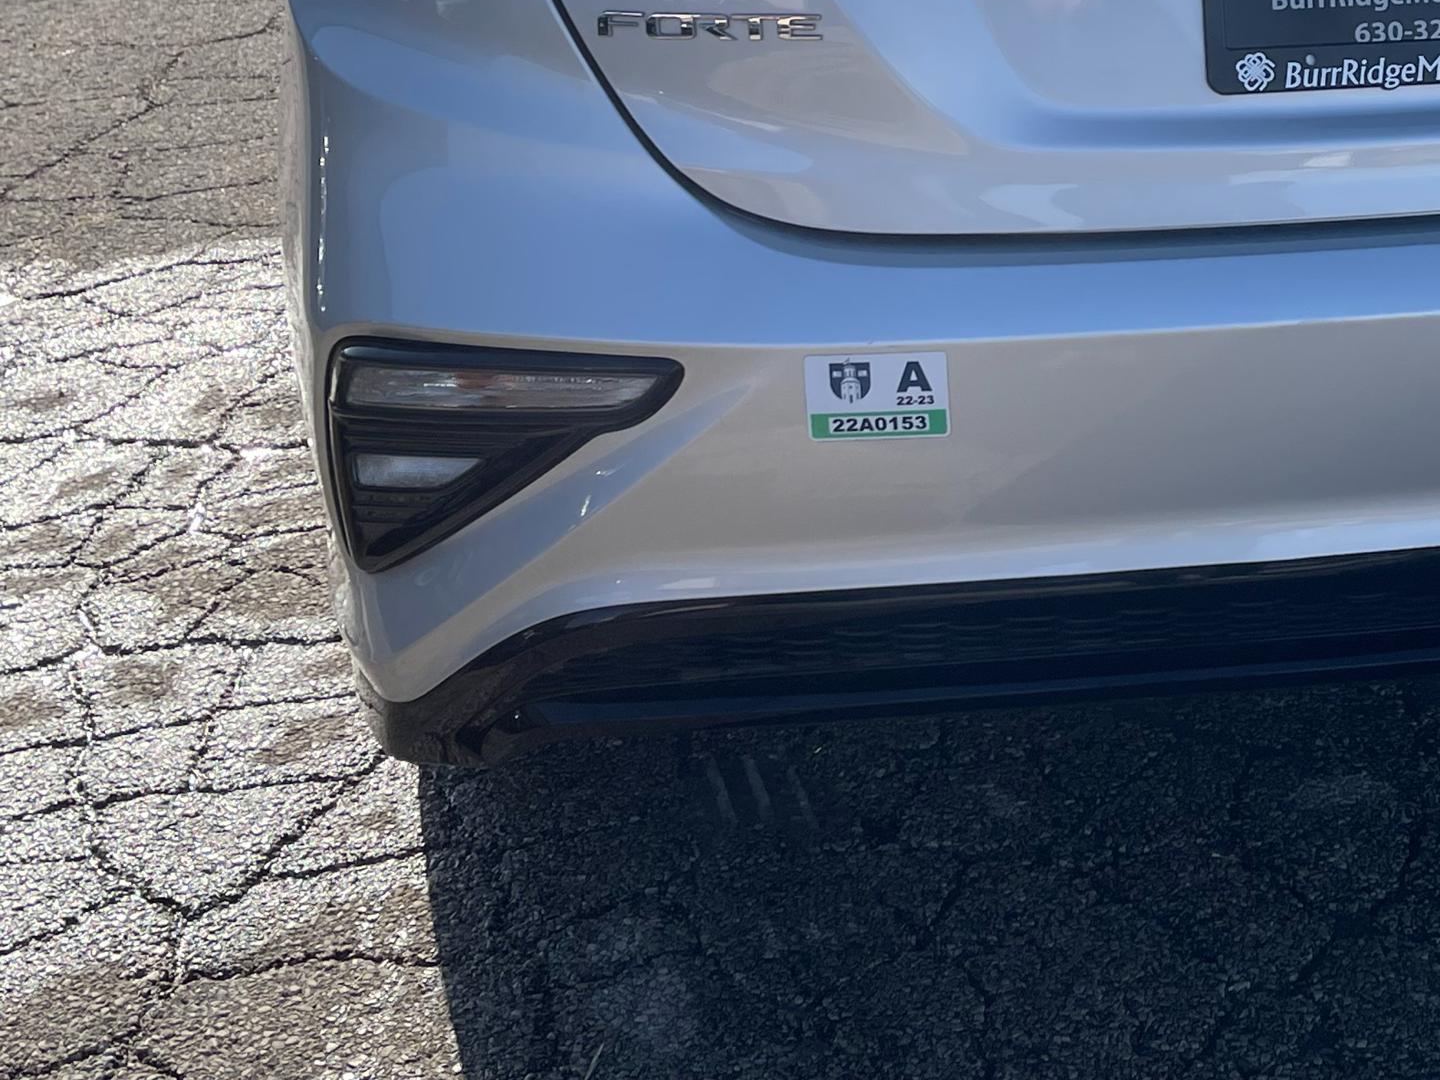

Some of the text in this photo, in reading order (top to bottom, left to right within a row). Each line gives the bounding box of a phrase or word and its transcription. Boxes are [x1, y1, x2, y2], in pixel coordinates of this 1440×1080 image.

[597, 10, 823, 41] FORTE
[896, 361, 933, 393] A
[896, 395, 935, 406] 22-23
[832, 415, 928, 433] 22A0153
